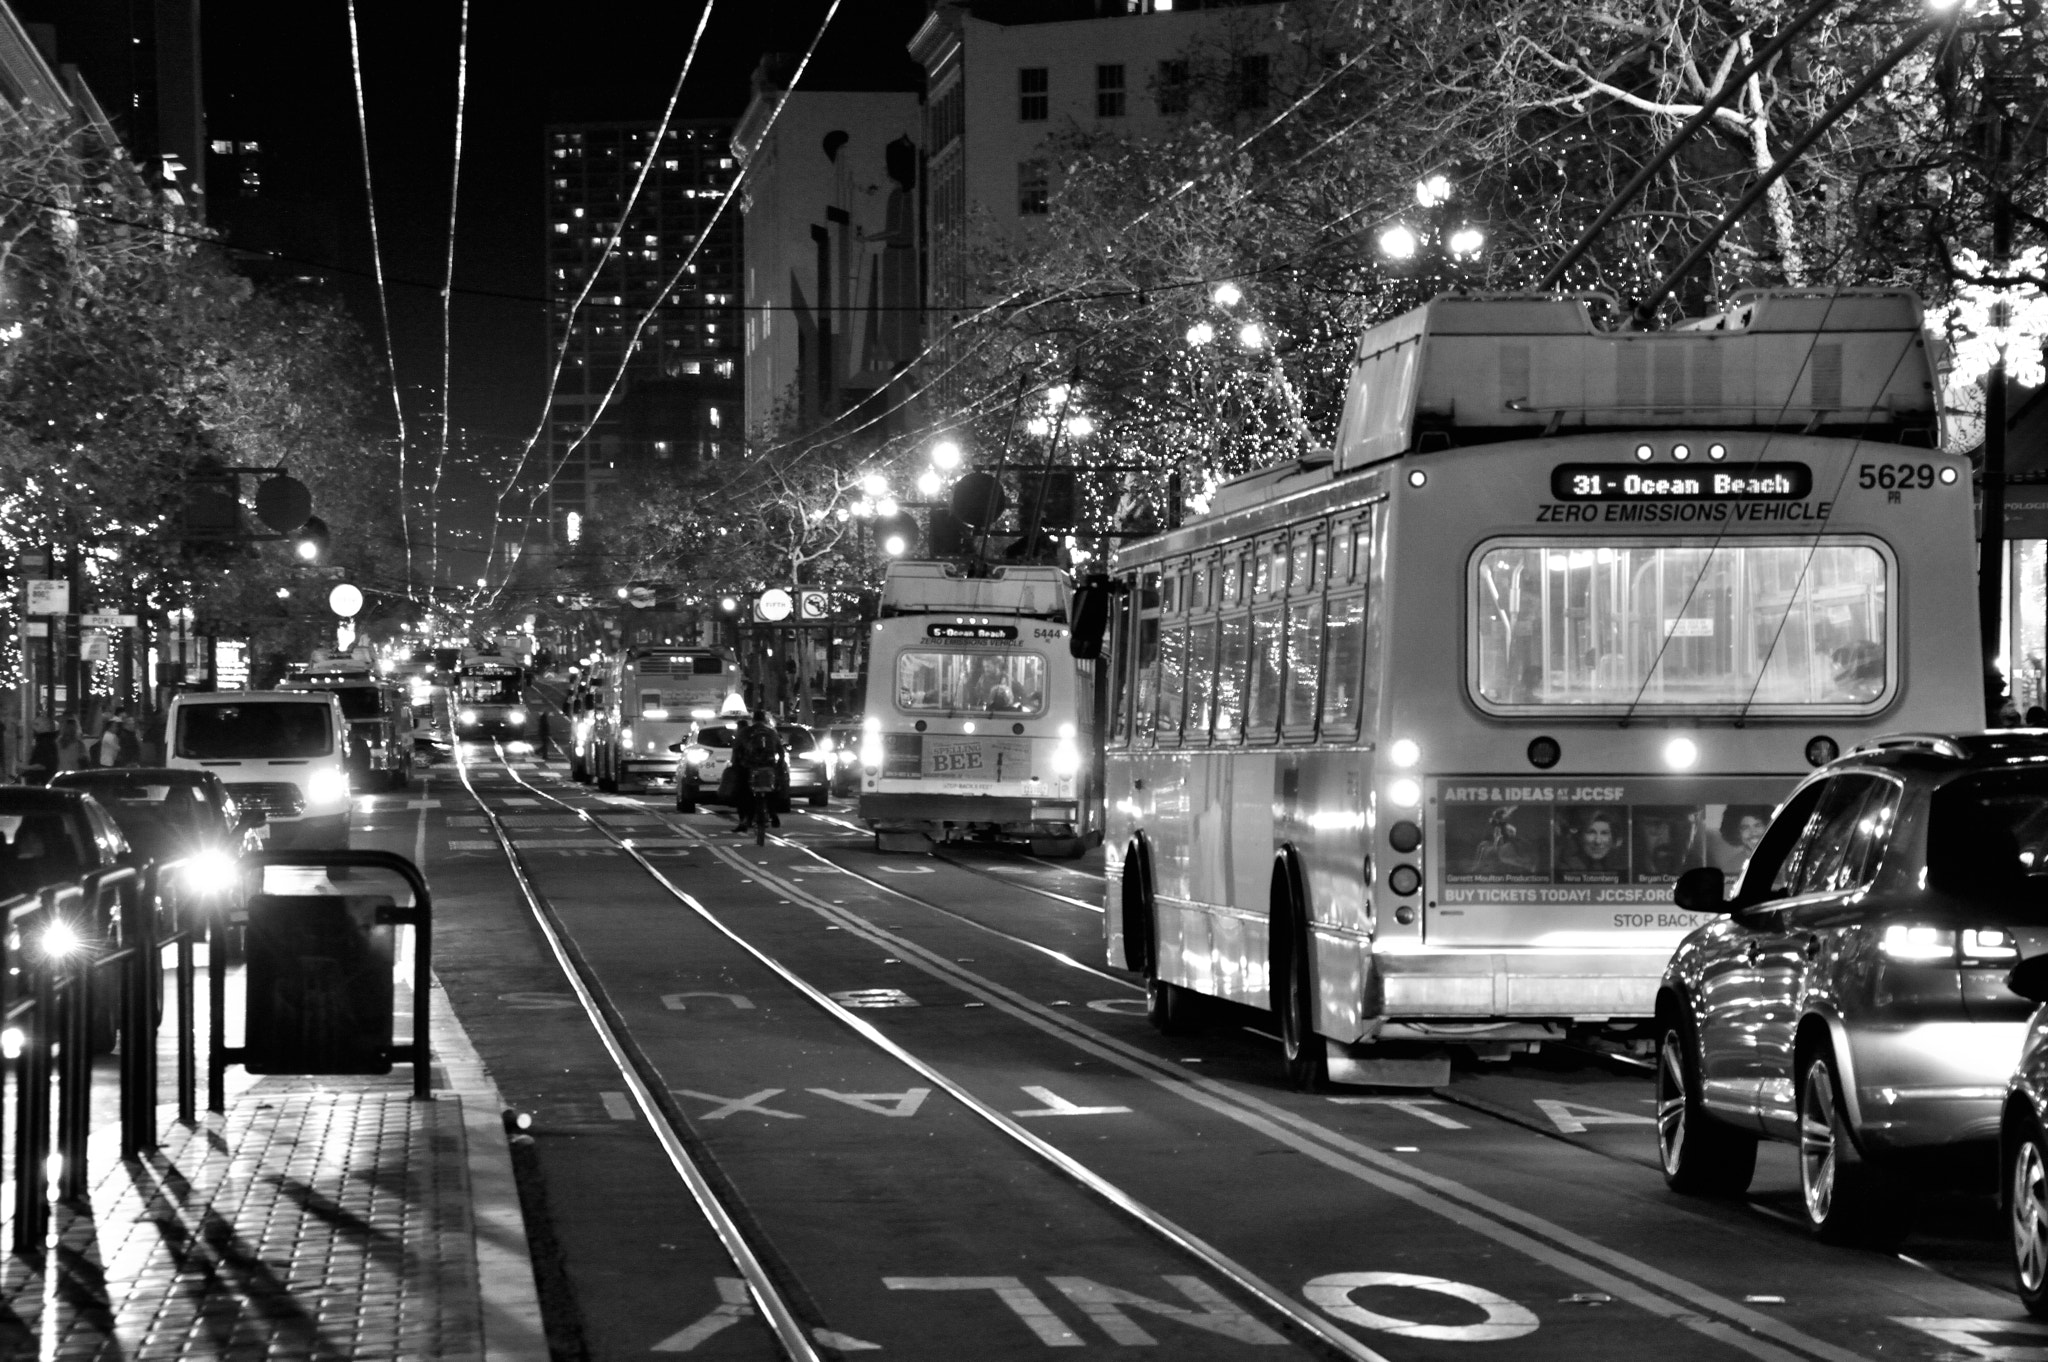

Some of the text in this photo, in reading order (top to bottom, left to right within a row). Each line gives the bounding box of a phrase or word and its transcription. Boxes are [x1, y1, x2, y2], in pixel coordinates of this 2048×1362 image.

[1713, 473, 1790, 495] Beach
[1858, 464, 1935, 490] 5629
[1537, 501, 1833, 523] ZERO EMISSIONS VEHICLE
[92, 616, 125, 625] POWELL
[1034, 628, 1061, 639] 5444
[920, 636, 1025, 648] ZERO EMISSIONS VEHICLE
[932, 751, 983, 772] BEE
[1445, 787, 1489, 801] ARTS
[1490, 787, 1502, 801] &
[1505, 787, 1554, 801] IDEAS
[1571, 787, 1625, 801] JCCSF
[1447, 874, 1549, 883] Garrett Moulton Productions
[1445, 889, 1675, 902] BUY TICKETS TODAY! JCCSF.ORG
[1613, 913, 1654, 927] STOP
[1658, 913, 1698, 928] BACK
